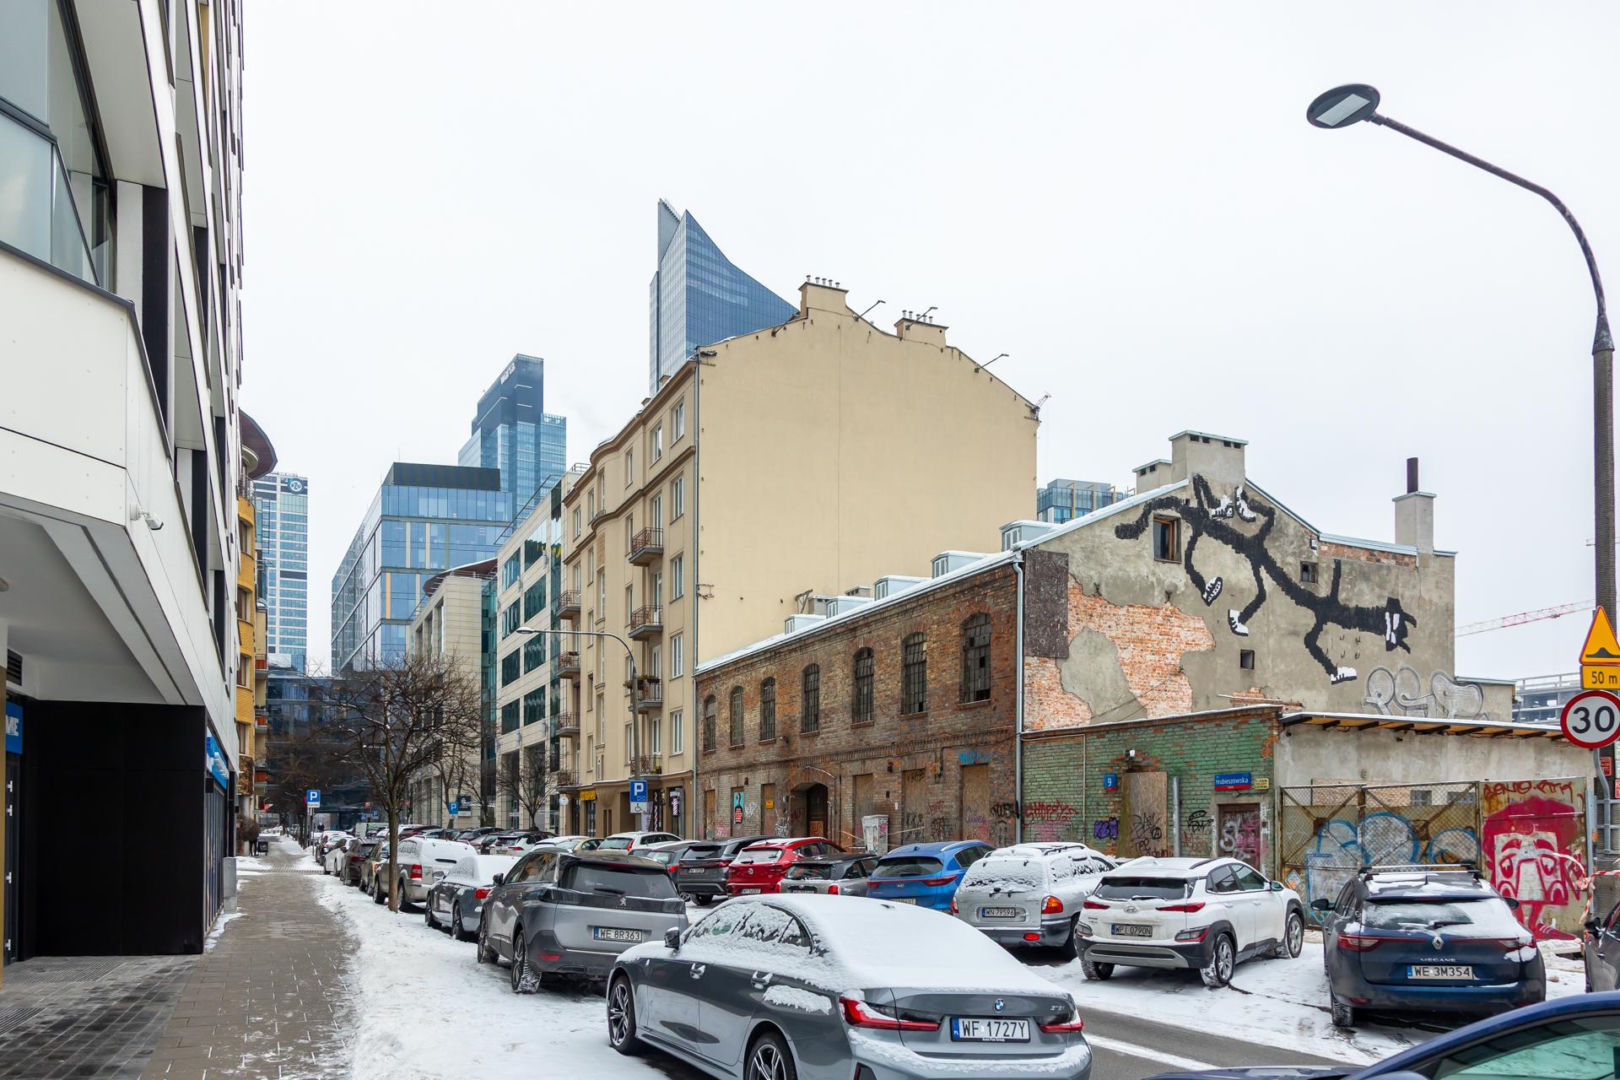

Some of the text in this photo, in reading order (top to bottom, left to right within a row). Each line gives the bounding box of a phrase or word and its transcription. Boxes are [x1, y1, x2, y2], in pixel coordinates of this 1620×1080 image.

[1591, 671, 1618, 684] 50 m
[1572, 706, 1615, 734] 30
[1107, 777, 1112, 787] 9
[634, 782, 644, 796] P
[310, 791, 318, 801] P
[600, 927, 612, 937] WE
[1414, 966, 1470, 977] WE 3M354
[962, 1020, 1026, 1038] WF 1727Y
